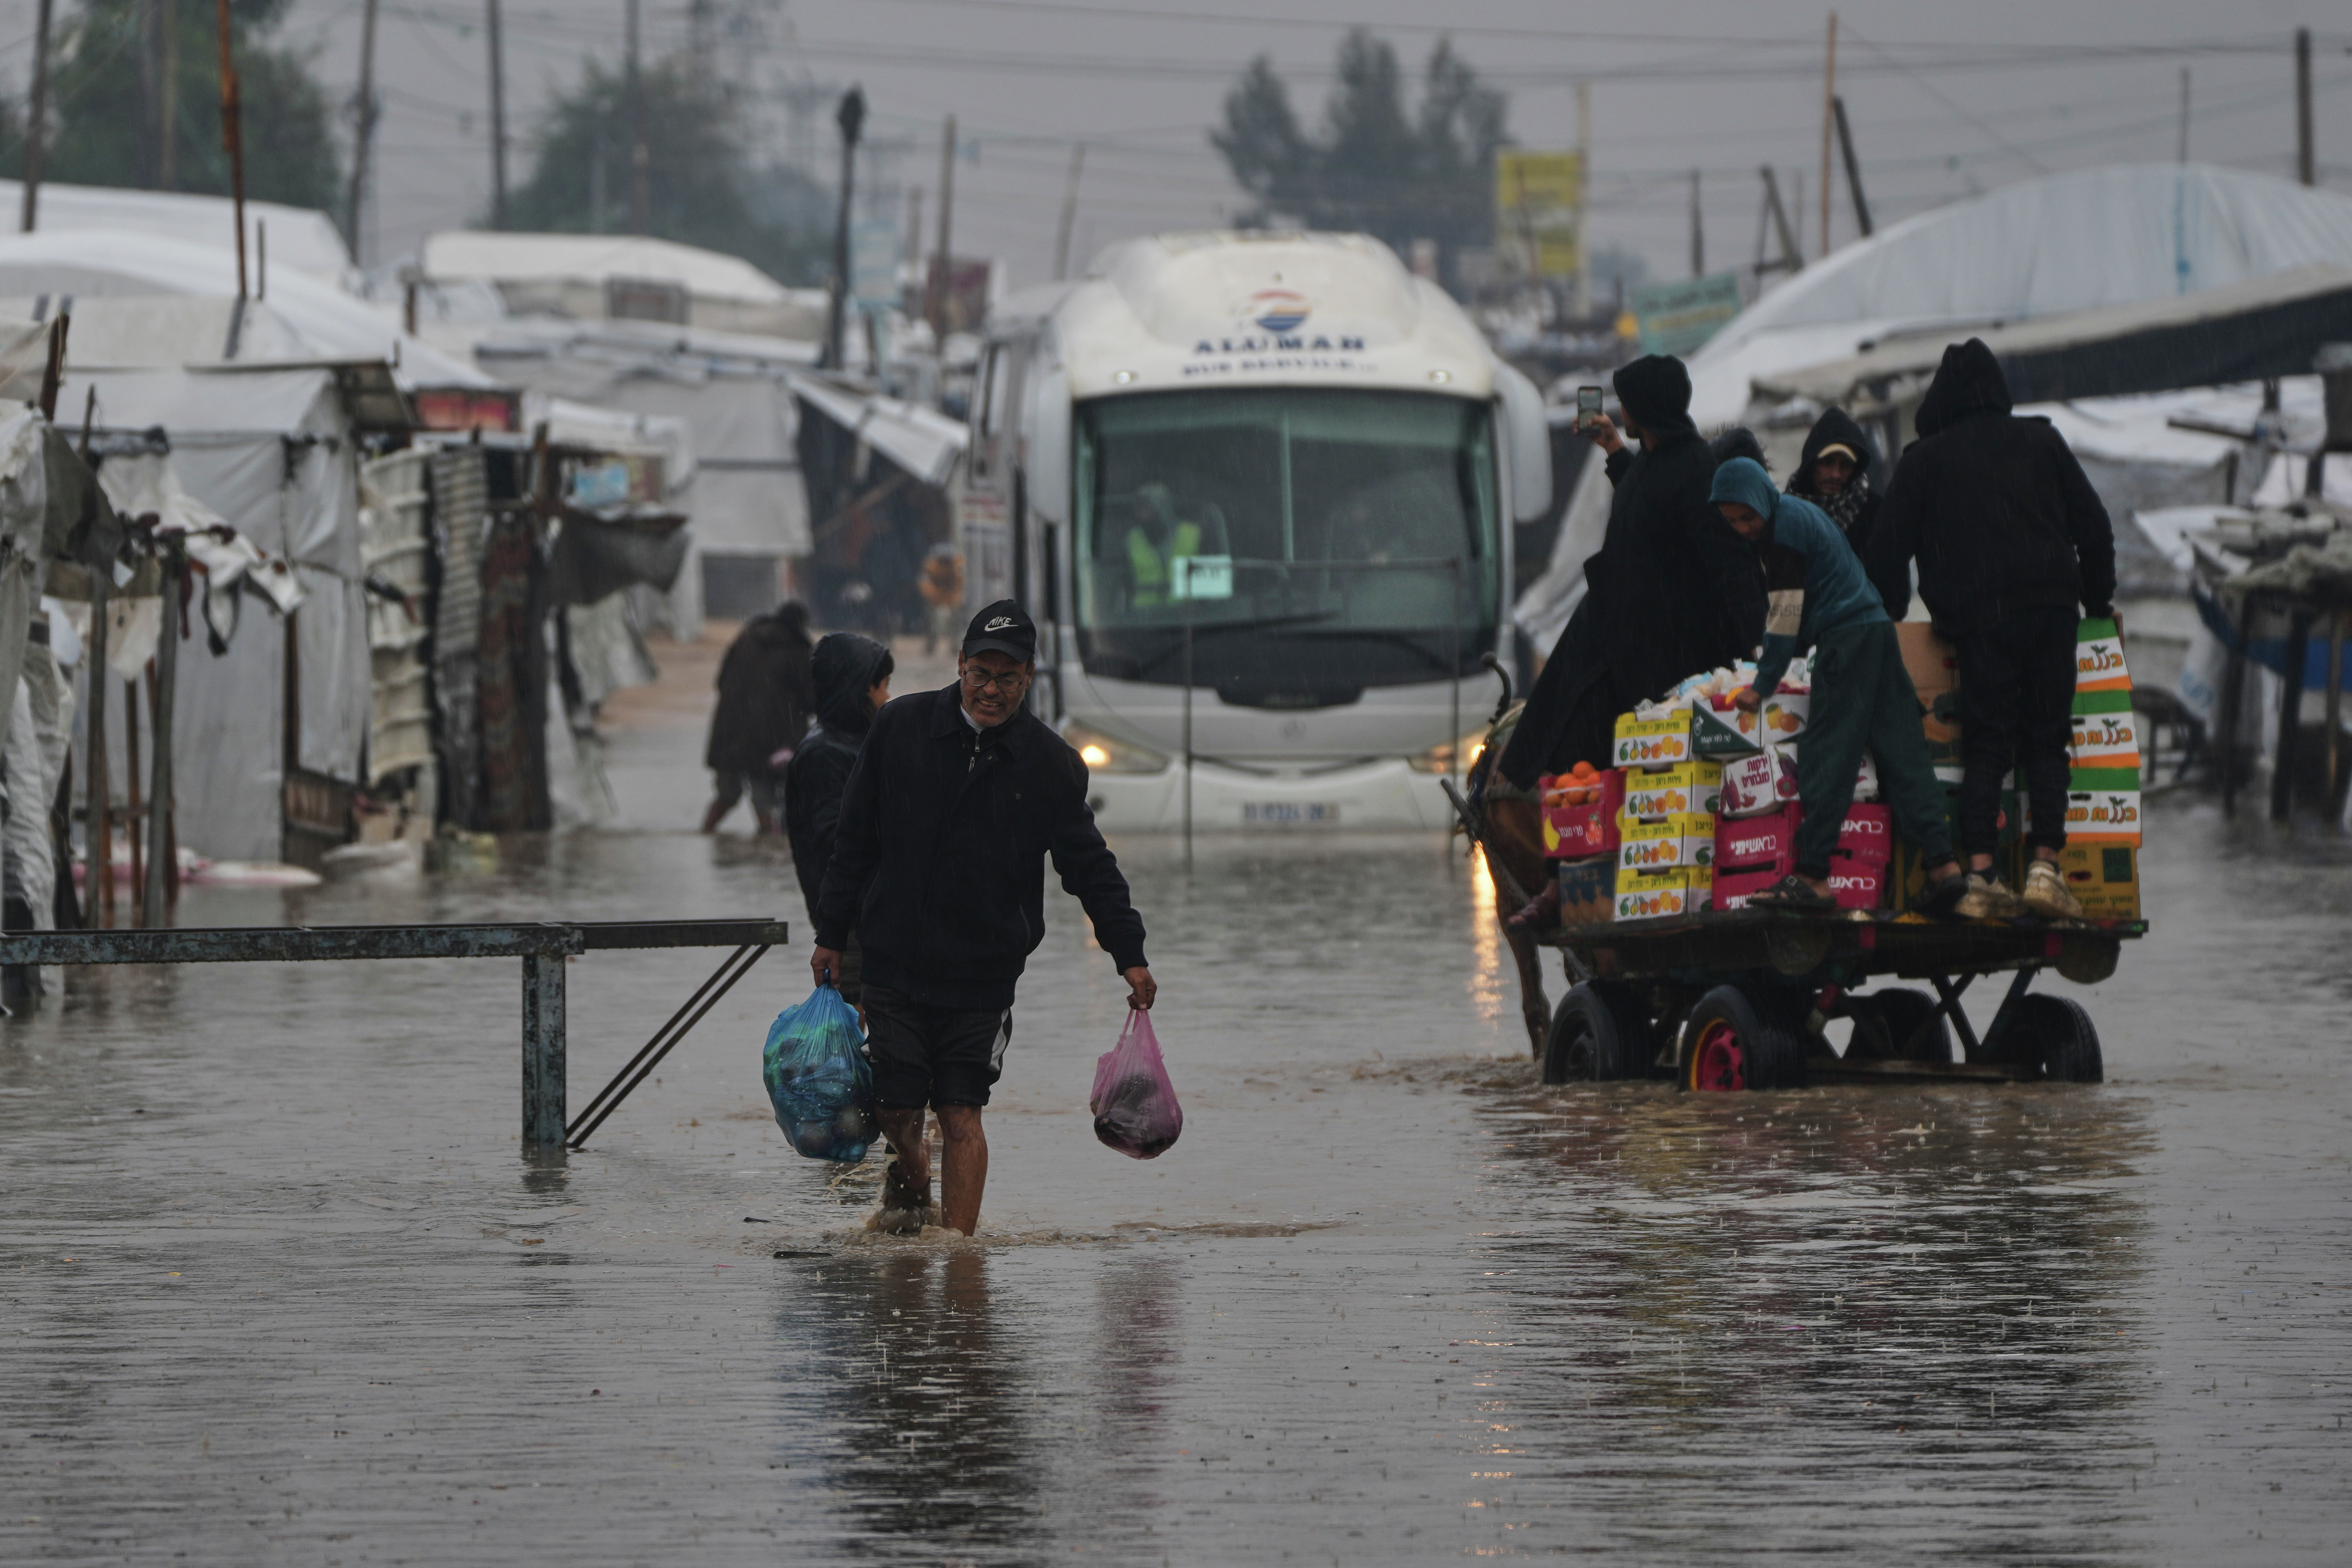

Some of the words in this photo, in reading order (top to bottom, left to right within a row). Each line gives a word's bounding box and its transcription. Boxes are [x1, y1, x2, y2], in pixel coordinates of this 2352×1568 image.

[989, 616, 1012, 627] NIKE
[2079, 653, 2123, 673] בננות
[2087, 728, 2132, 746] בננות
[1747, 757, 1768, 774] ירקות
[1656, 777, 1666, 787] ניצן
[1668, 775, 1682, 784] פירות
[1742, 771, 1770, 788] מובחרים
[2091, 806, 2137, 824] בננות
[1559, 826, 1573, 838] מובחר
[1573, 825, 1583, 836] פרי
[1696, 820, 1713, 832] ניצן
